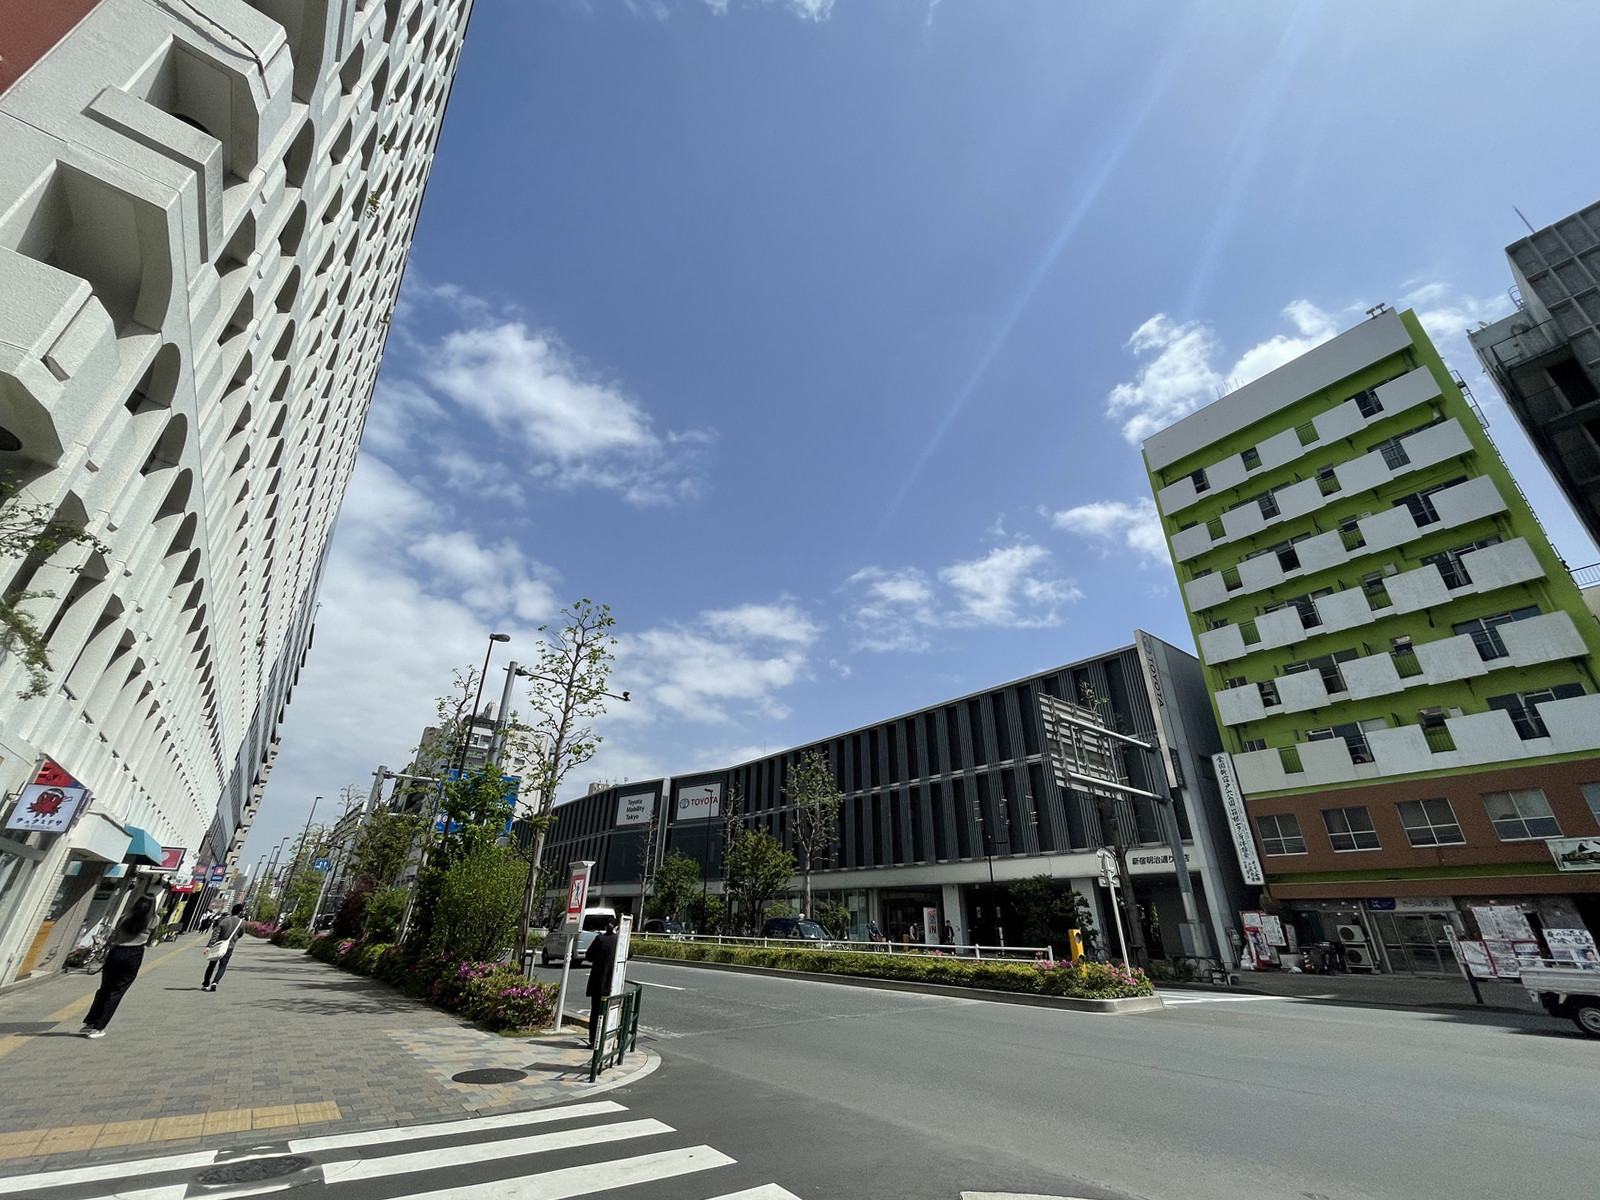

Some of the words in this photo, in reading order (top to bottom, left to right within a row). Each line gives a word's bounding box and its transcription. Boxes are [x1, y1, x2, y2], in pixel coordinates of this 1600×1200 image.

[1148, 657, 1165, 708] TOYOTA
[627, 799, 643, 807] Toyota
[691, 796, 718, 806] TOYOTA
[626, 806, 645, 814] Mobility
[1132, 854, 1190, 866] 新宿明治通り店
